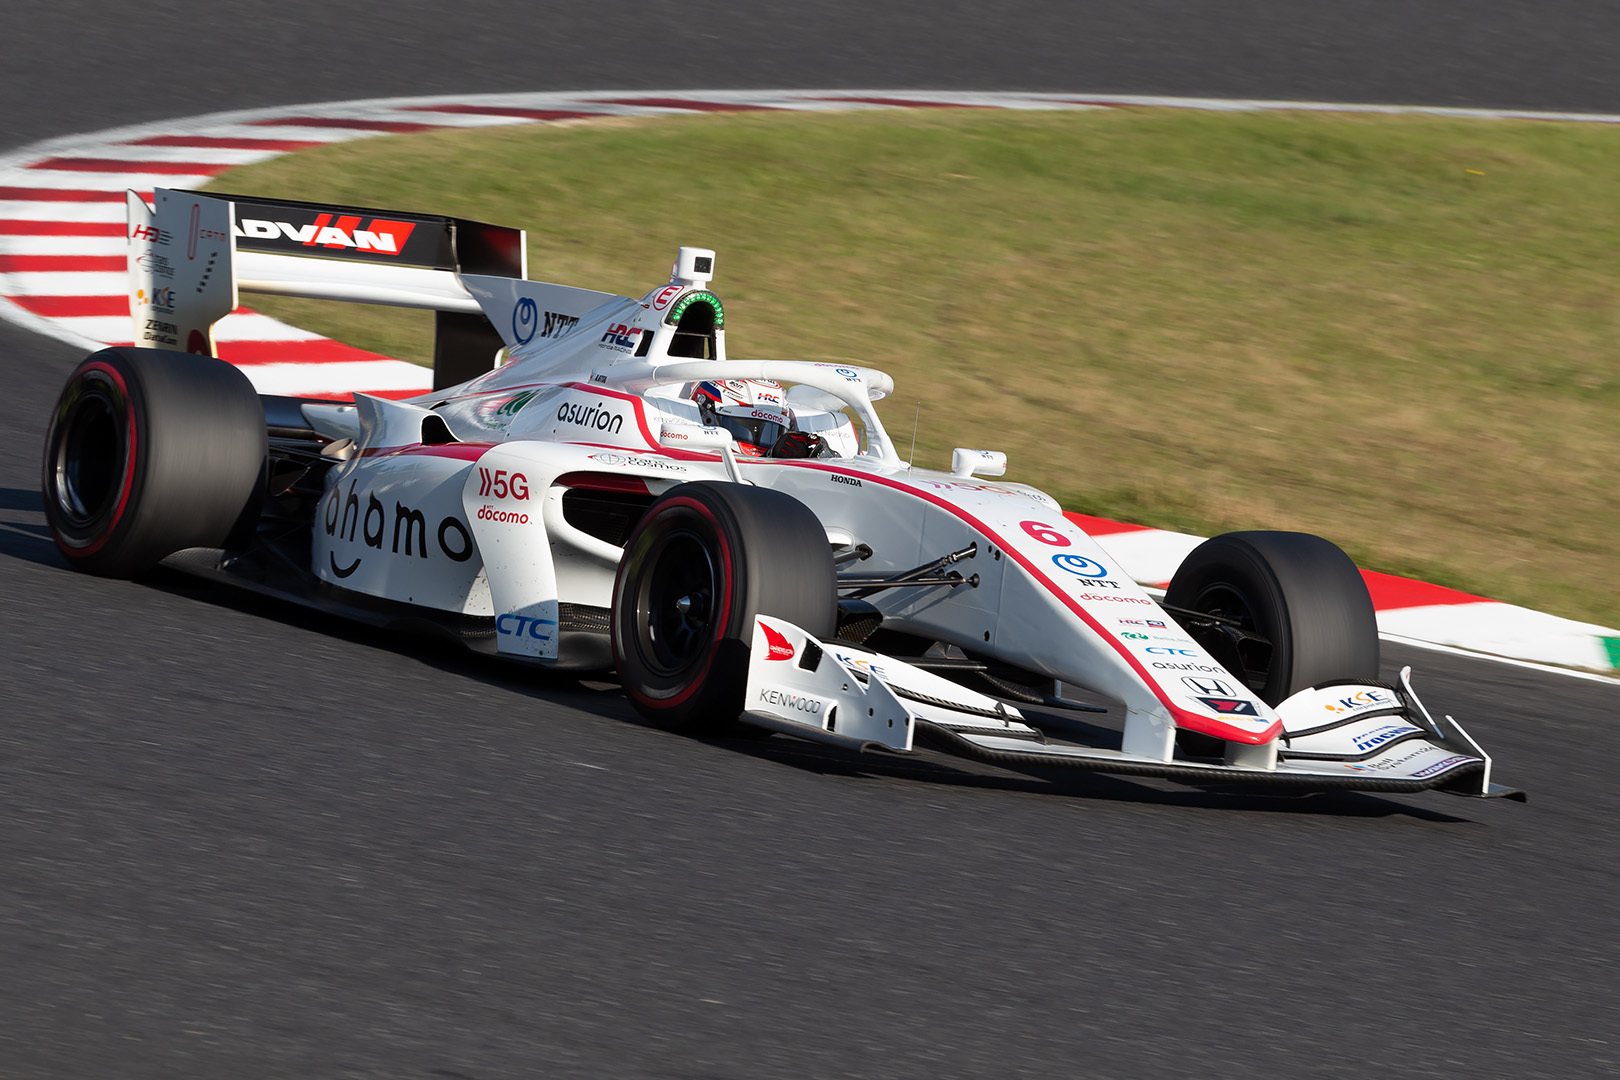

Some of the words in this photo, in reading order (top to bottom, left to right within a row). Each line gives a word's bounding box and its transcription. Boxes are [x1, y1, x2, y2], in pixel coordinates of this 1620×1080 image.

[656, 286, 680, 305] E
[541, 311, 580, 338] NTT
[601, 323, 642, 348] HRC
[557, 401, 623, 435] asurion
[751, 409, 783, 424] docomo
[830, 474, 863, 488] HONDA
[325, 478, 473, 562] ahamo
[477, 505, 529, 525] docomo
[1019, 520, 1072, 547] 6
[1076, 578, 1120, 588] NTT
[1080, 592, 1151, 606] docomo
[496, 613, 558, 641] CTC
[1145, 646, 1199, 658] CTC
[1152, 661, 1226, 675] asurion
[759, 688, 822, 714] KENWOOD
